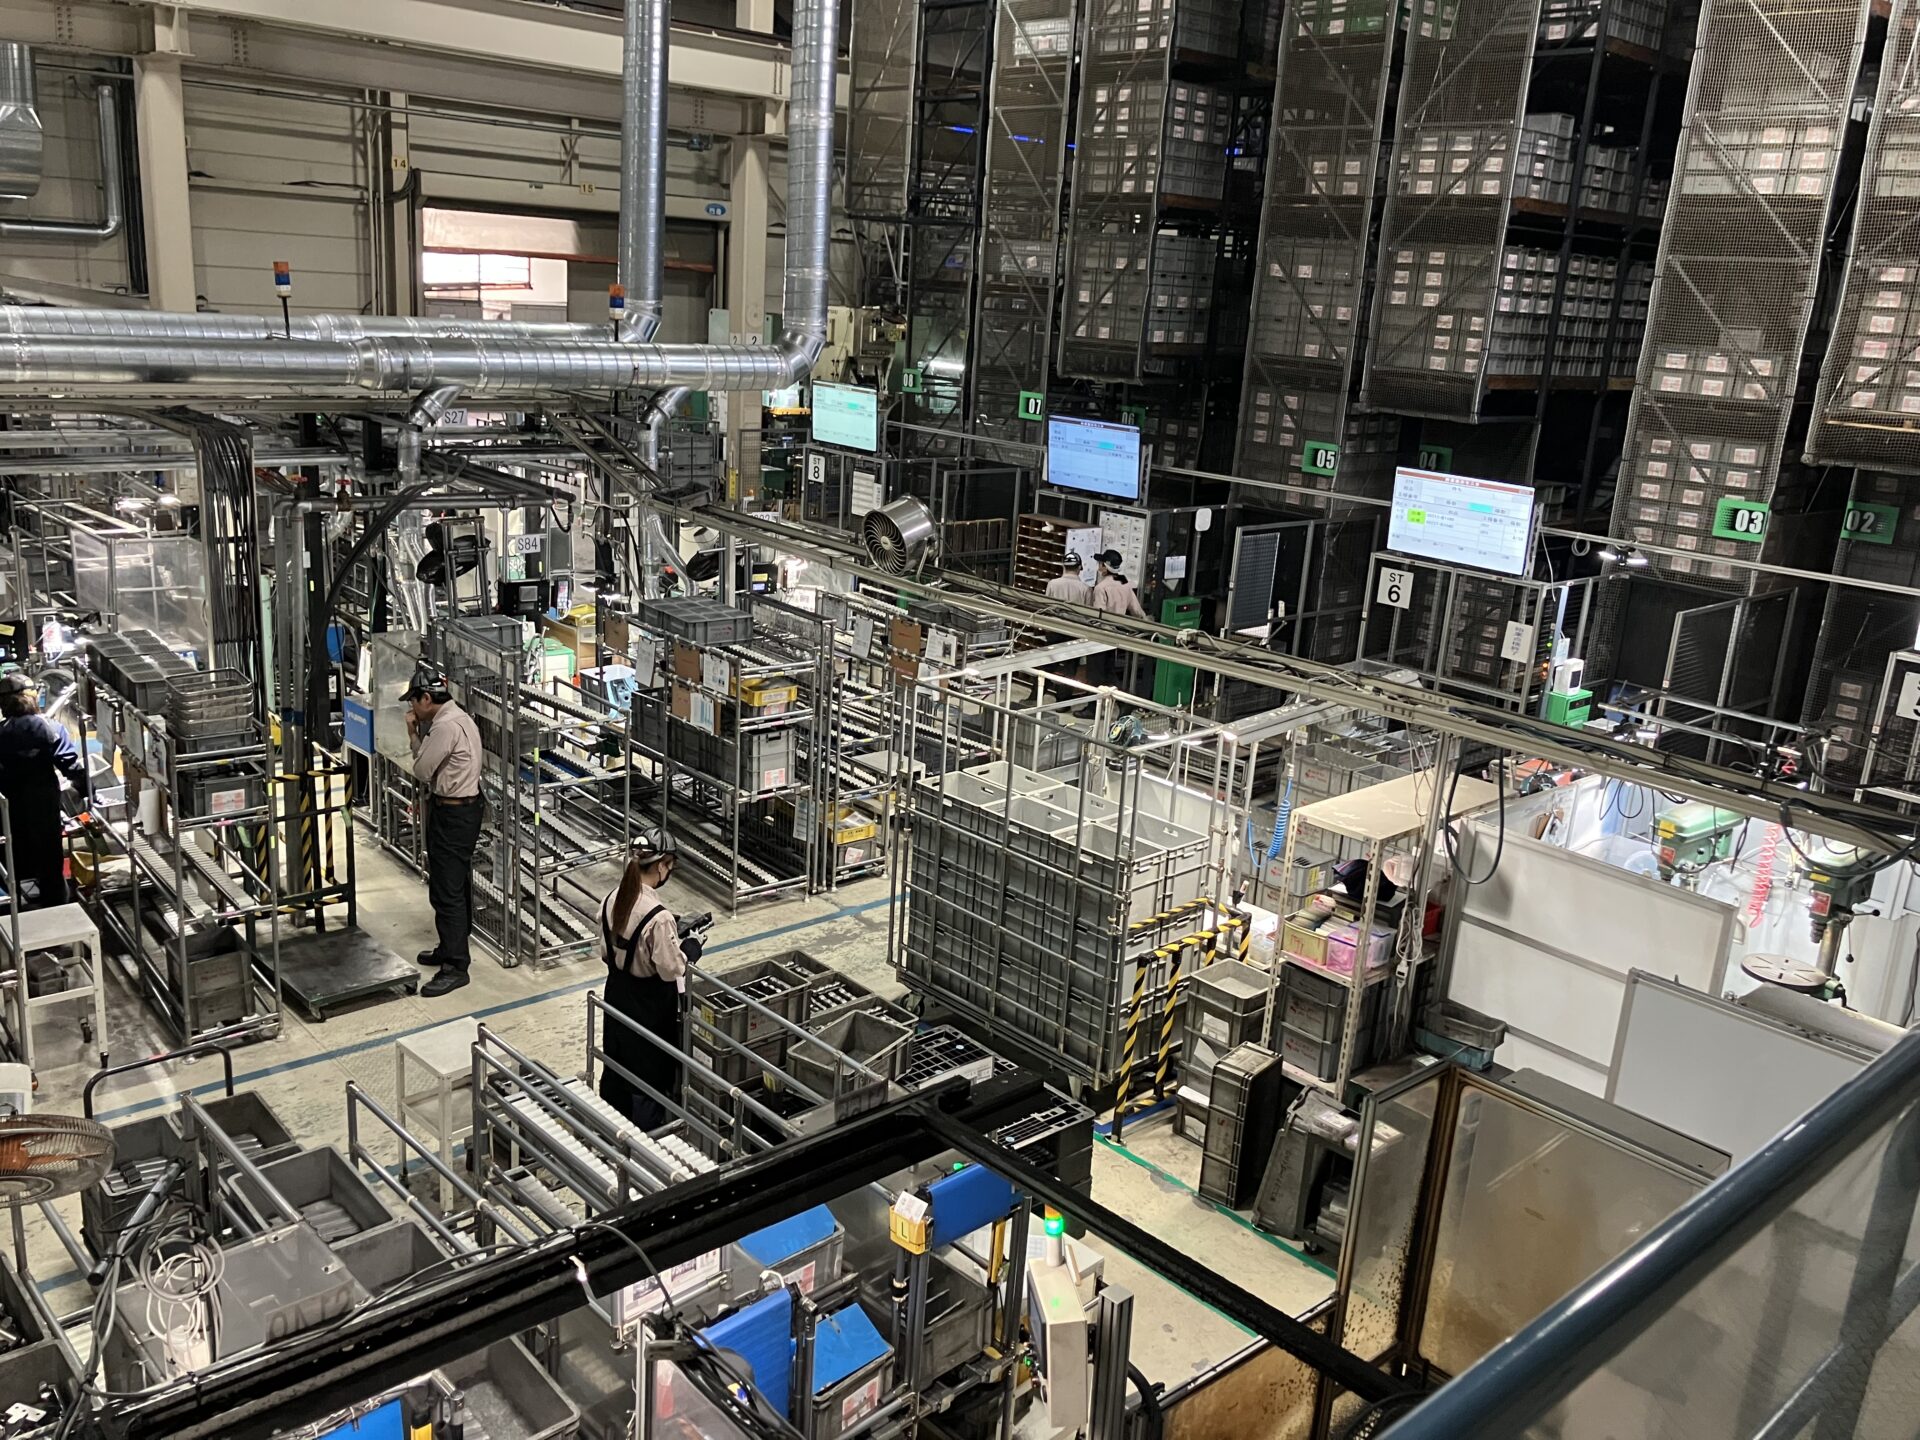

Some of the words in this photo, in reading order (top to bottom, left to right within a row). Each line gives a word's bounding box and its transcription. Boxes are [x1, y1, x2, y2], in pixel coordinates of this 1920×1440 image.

[394, 159, 406, 169] 14
[582, 183, 594, 193] 15
[903, 373, 914, 388] 08
[1028, 398, 1042, 415] 07
[444, 410, 465, 424] S27
[1316, 449, 1336, 469] 05
[1419, 451, 1438, 470] 04
[813, 466, 820, 479] 8
[1734, 509, 1764, 534] 03
[1845, 509, 1875, 533] 02
[517, 536, 538, 551] S84
[1388, 572, 1405, 584] ST
[1387, 583, 1401, 604] 6
[900, 1221, 908, 1239] L
